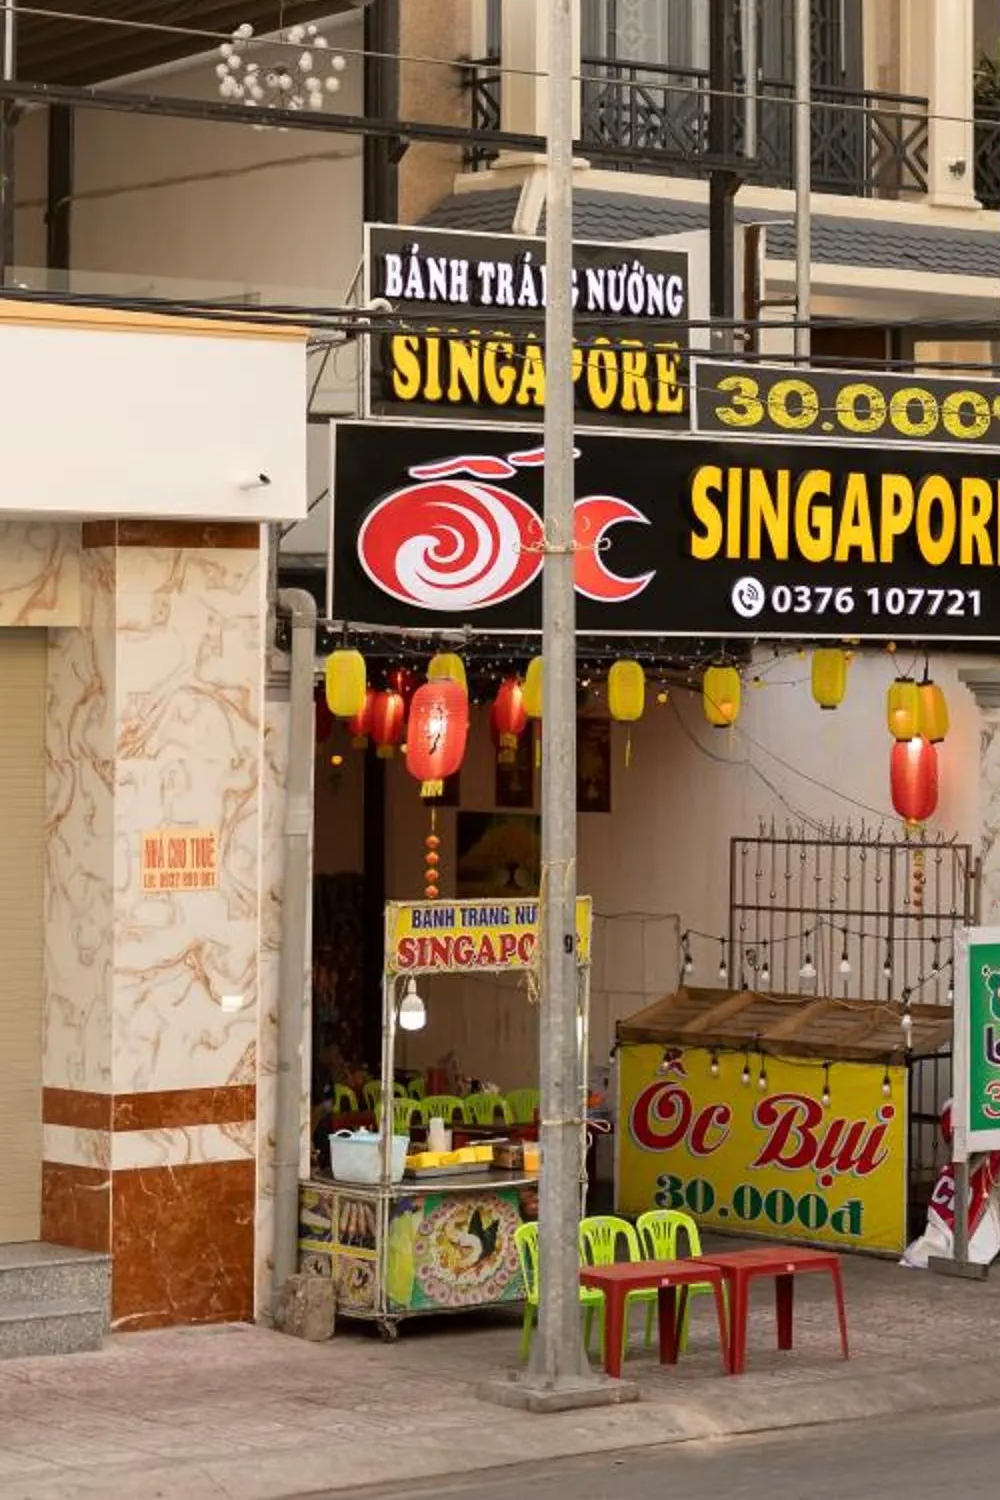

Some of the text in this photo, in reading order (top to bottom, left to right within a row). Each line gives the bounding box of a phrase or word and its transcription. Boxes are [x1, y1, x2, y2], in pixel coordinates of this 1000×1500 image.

[384, 242, 685, 317] BÁNH TRÁ NƯỚNG
[391, 326, 685, 414] SINGAORE
[771, 584, 983, 618] 0376 107721
[397, 933, 581, 969] SINGAPO
[563, 933, 573, 954] 9
[750, 1092, 896, 1188] Bụi
[655, 1174, 865, 1236] 30.000đ
